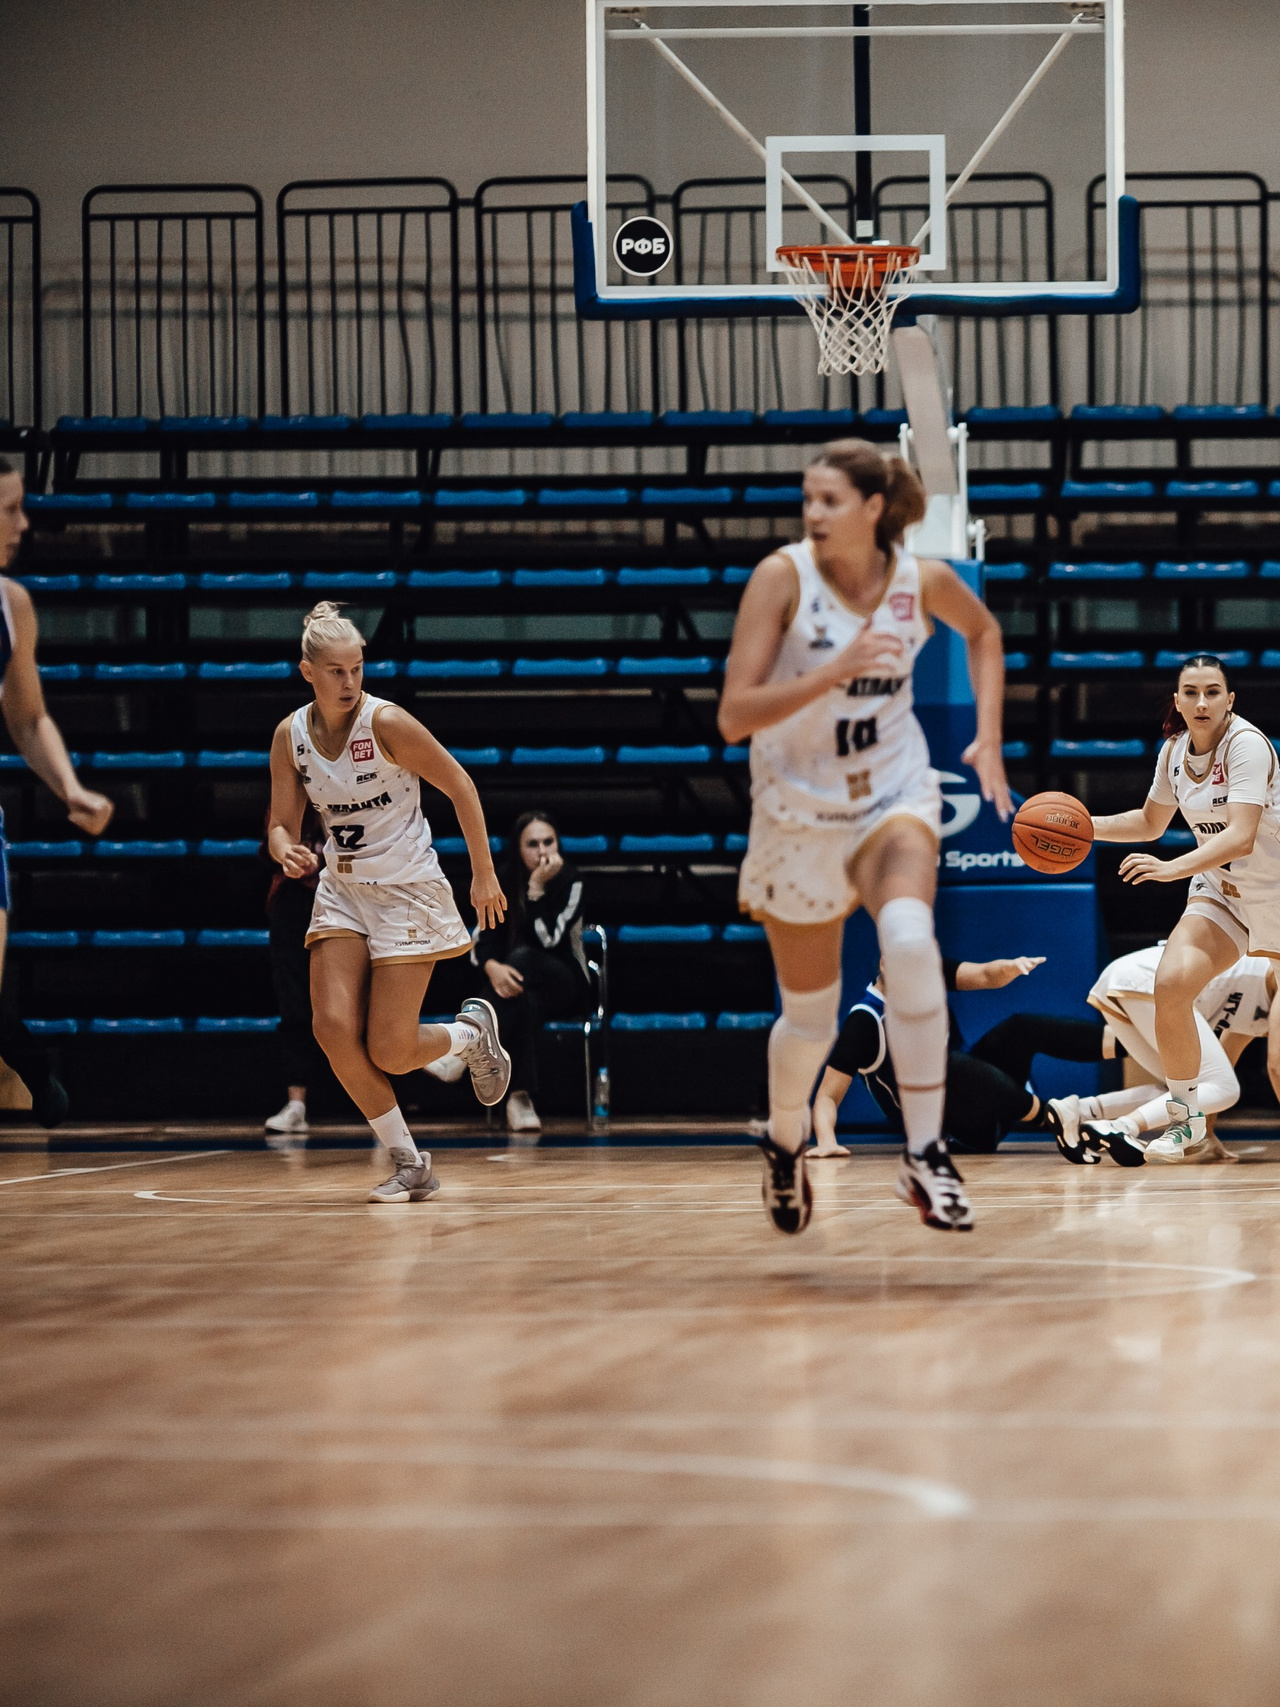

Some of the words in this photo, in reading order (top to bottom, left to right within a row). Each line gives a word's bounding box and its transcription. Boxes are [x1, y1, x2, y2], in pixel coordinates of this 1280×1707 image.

[621, 238, 666, 255] РФБ
[353, 741, 372, 751] FON
[836, 716, 878, 757] 10
[354, 749, 373, 760] BET
[329, 825, 368, 850] 12
[945, 850, 1026, 872] Sports
